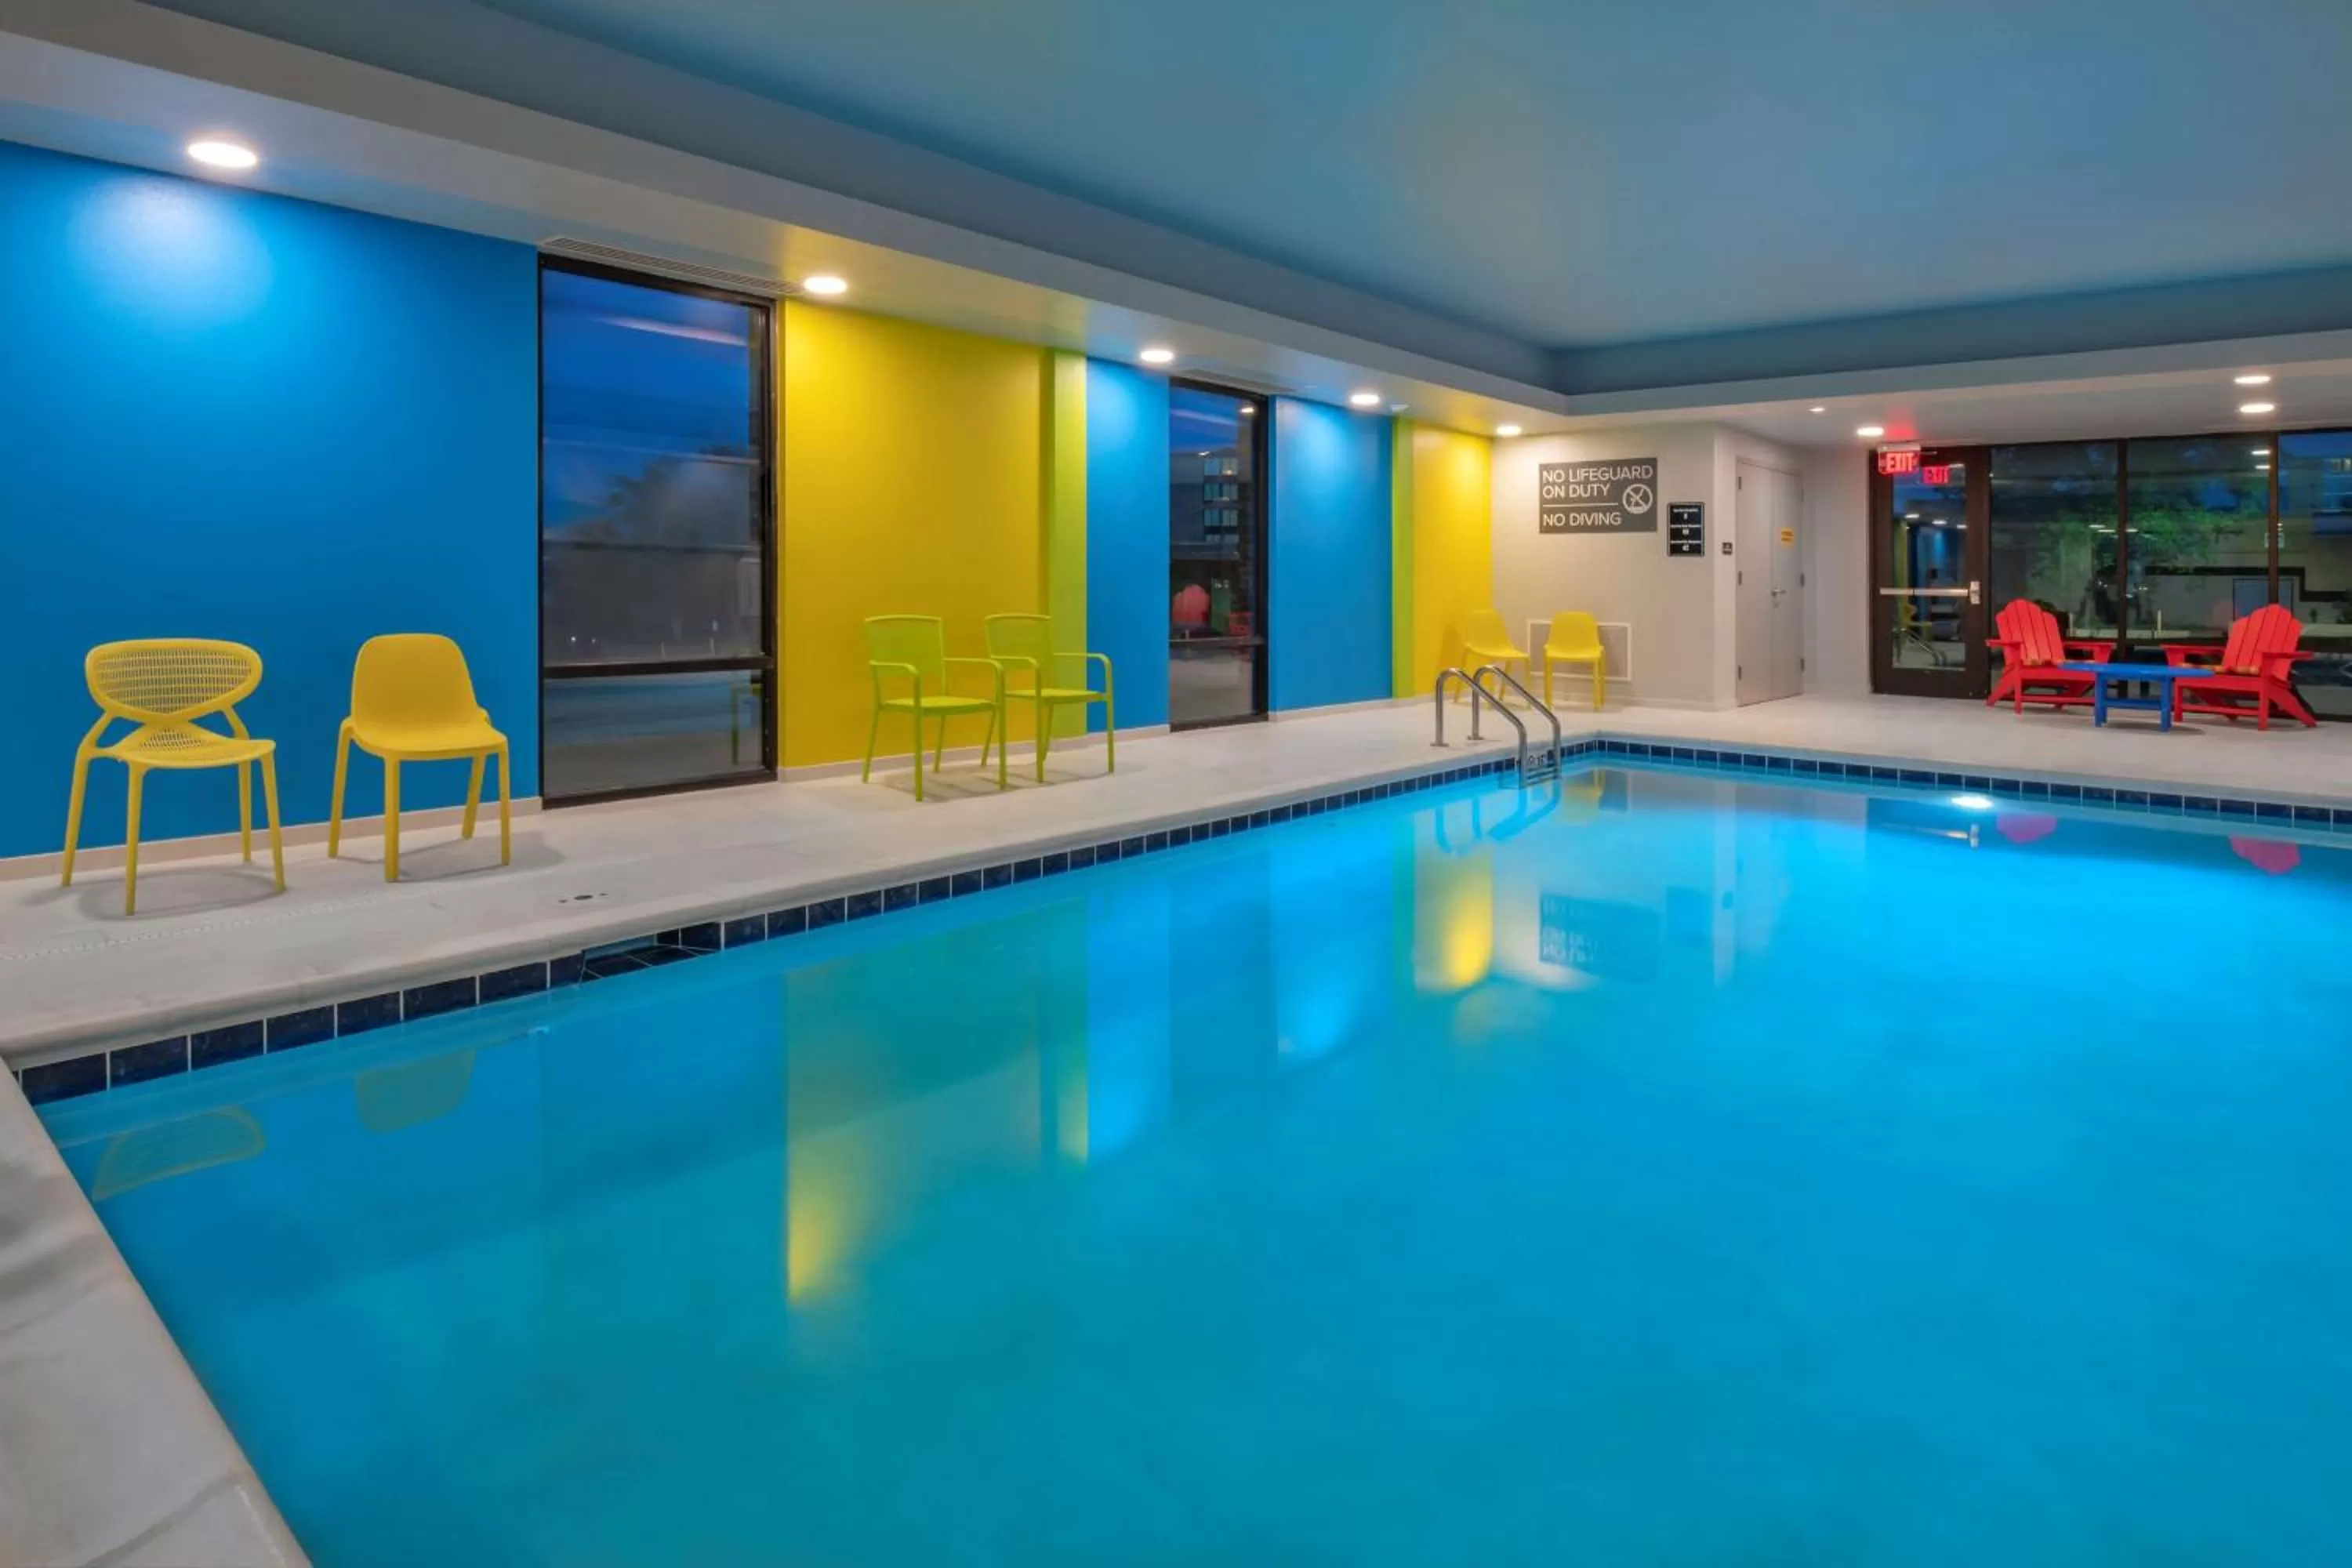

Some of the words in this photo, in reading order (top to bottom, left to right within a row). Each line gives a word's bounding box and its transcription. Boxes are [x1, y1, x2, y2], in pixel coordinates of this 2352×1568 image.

[1886, 452, 1915, 472] EXIT
[1542, 470, 1565, 483] NO
[1569, 465, 1653, 482] LIFEGUARD
[1923, 466, 1950, 485] EXIT
[1542, 484, 1565, 499] ON
[1569, 482, 1611, 498] DUTY
[1542, 513, 1566, 527] NO
[1569, 511, 1622, 527] DIVING
